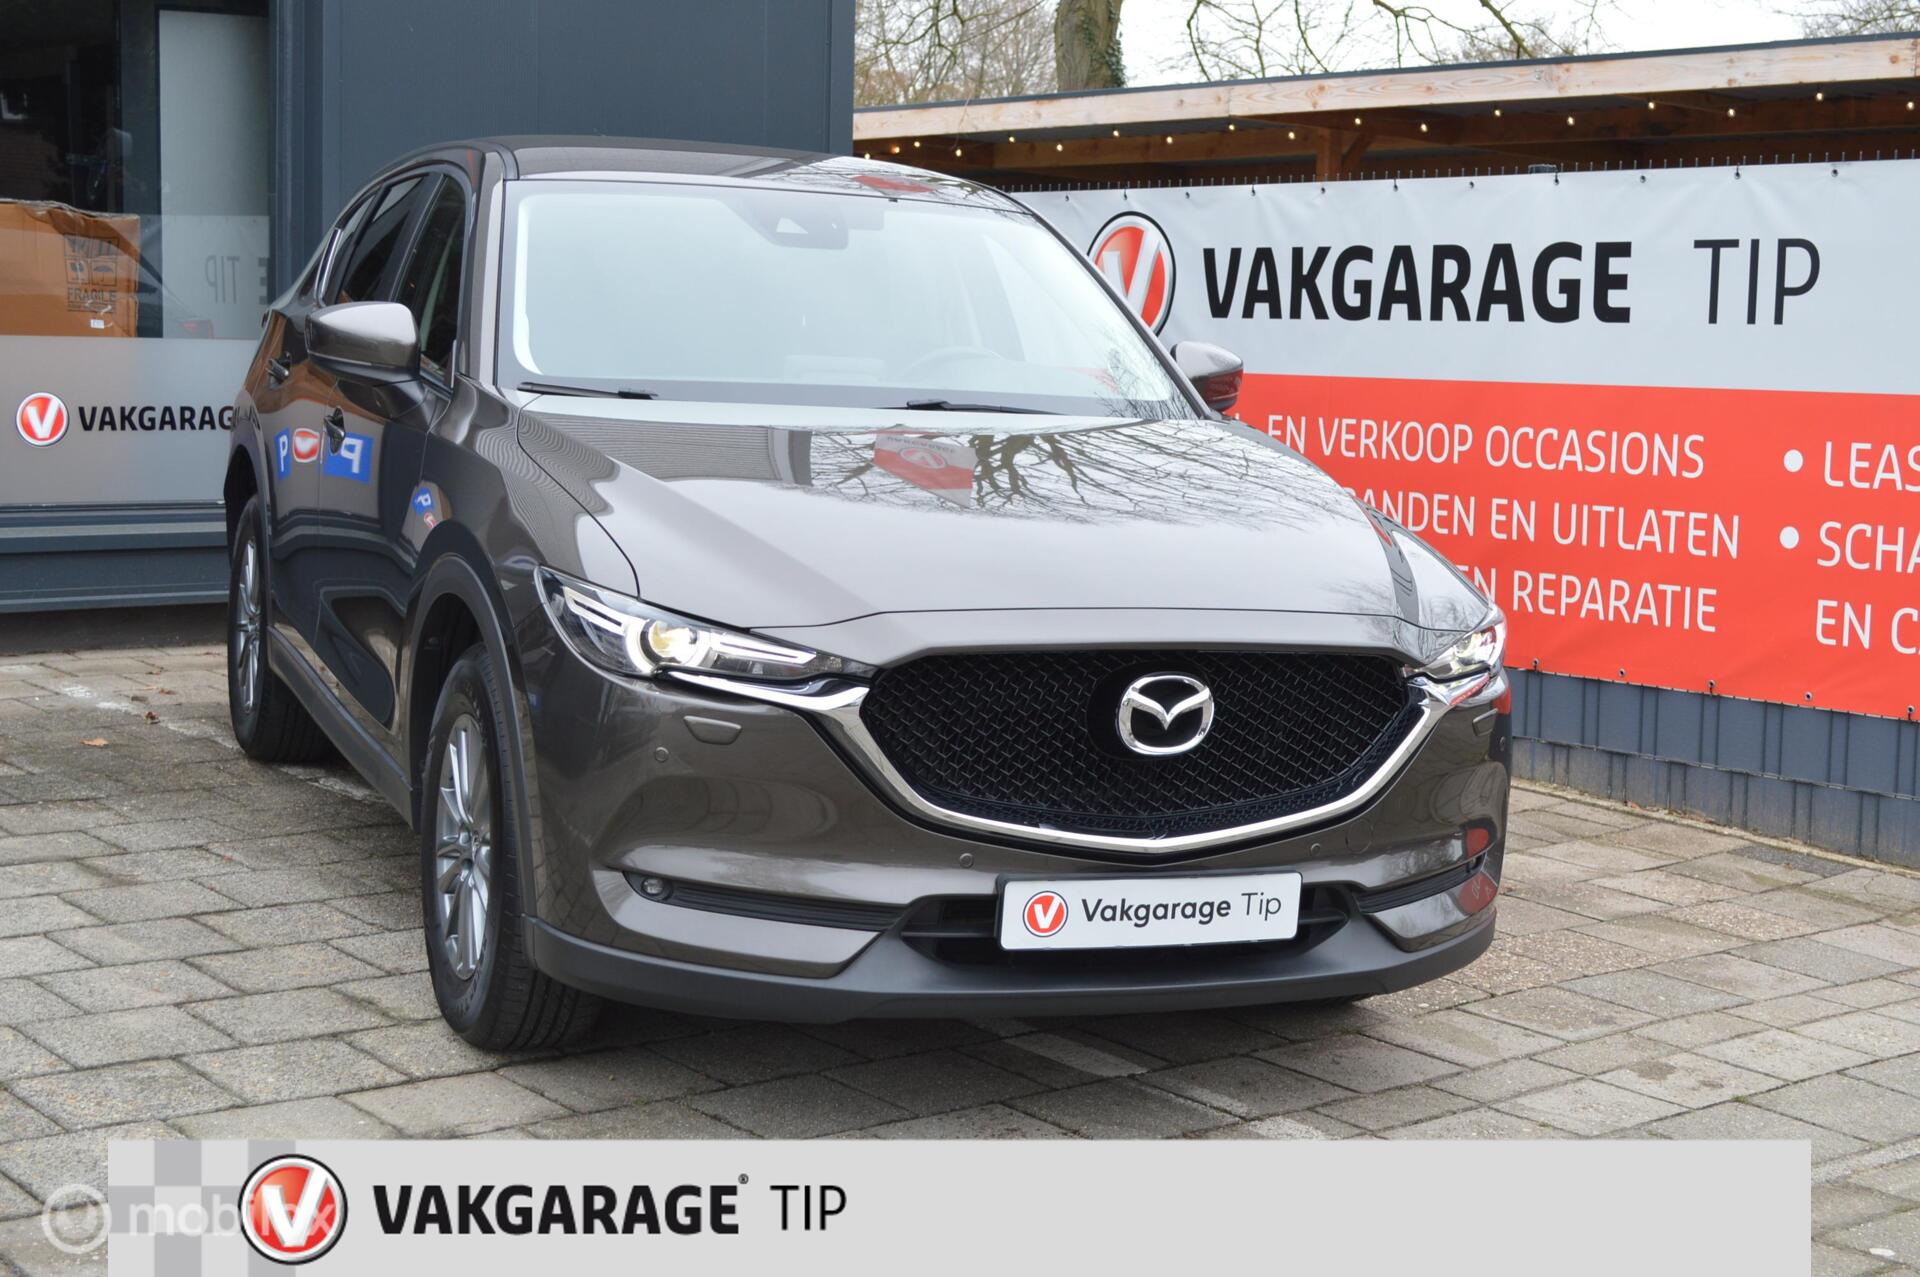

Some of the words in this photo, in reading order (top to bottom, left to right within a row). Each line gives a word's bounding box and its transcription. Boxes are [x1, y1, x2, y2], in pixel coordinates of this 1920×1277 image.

[1203, 241, 1632, 324] VAKGARAGE
[1693, 238, 1820, 325] TIP
[1318, 416, 1474, 465] VERKOOP
[1486, 425, 1705, 479] OCCASIONS
[1824, 440, 1920, 493] LEAS
[1343, 487, 1476, 537] NDEN
[1490, 497, 1536, 542] EN
[1553, 502, 1740, 559] UITLATEN
[1513, 570, 1717, 633] REPARATIE
[1815, 599, 1872, 649] EN
[1891, 607, 1920, 655] C
[1081, 898, 1232, 928] Vakgarage
[1241, 892, 1282, 921] Tip
